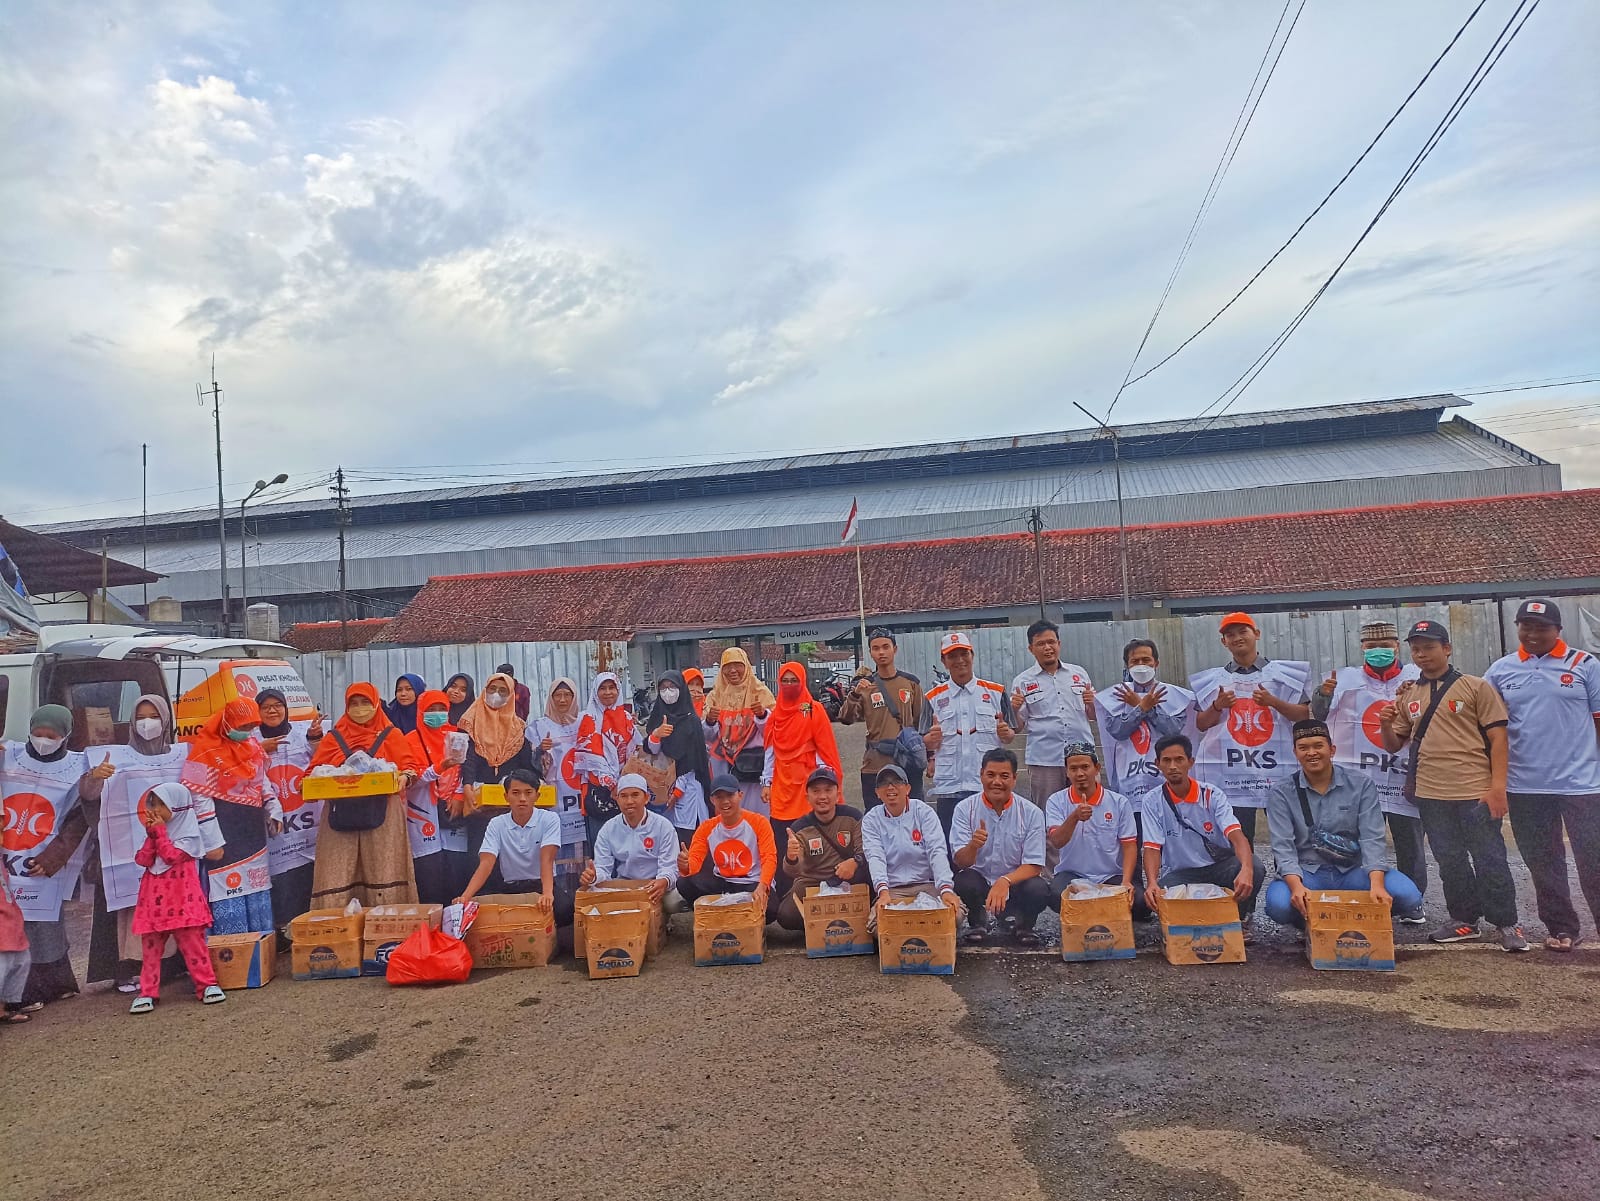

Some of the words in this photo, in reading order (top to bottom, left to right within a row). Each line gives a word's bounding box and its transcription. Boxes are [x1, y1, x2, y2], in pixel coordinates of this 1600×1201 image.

[1127, 758, 1160, 778] PKS
[1227, 748, 1278, 769] PKS
[282, 811, 315, 834] KS
[226, 886, 243, 896] PKS
[597, 960, 634, 969] EQUADO
